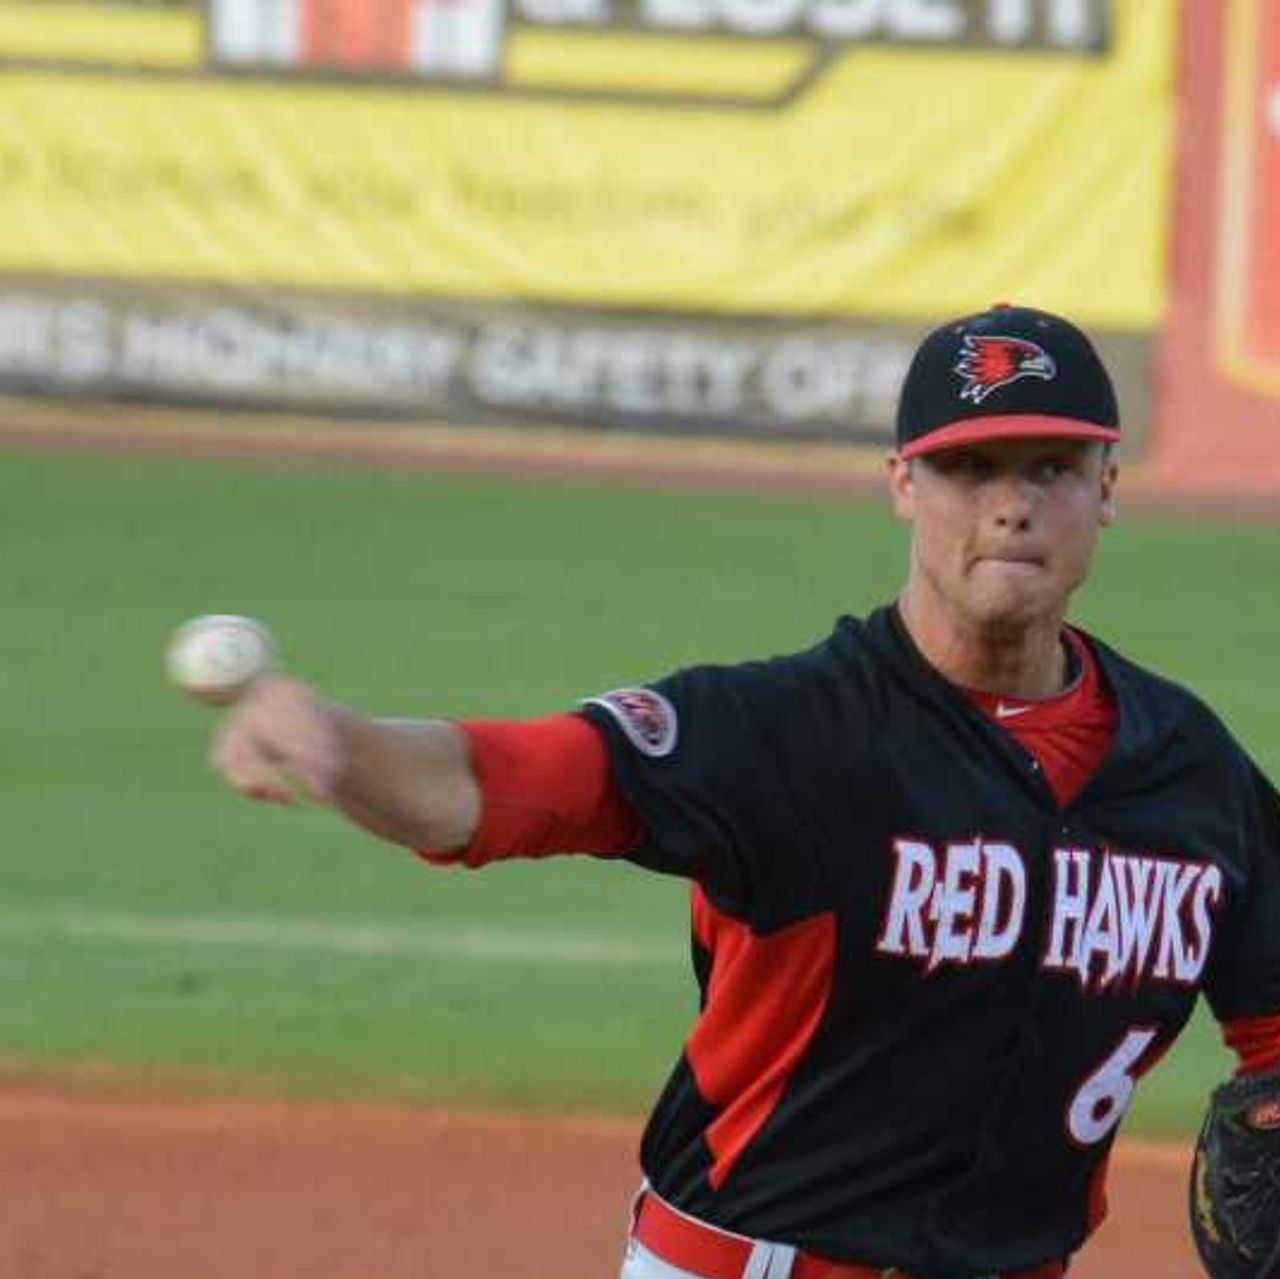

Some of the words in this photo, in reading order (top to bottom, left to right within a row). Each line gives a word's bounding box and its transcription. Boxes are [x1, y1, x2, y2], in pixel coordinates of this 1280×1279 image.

[468, 316, 754, 410] SAFETY
[876, 836, 1028, 974] RED
[1042, 844, 1222, 990] HAWKS
[1070, 1028, 1158, 1146] 6
